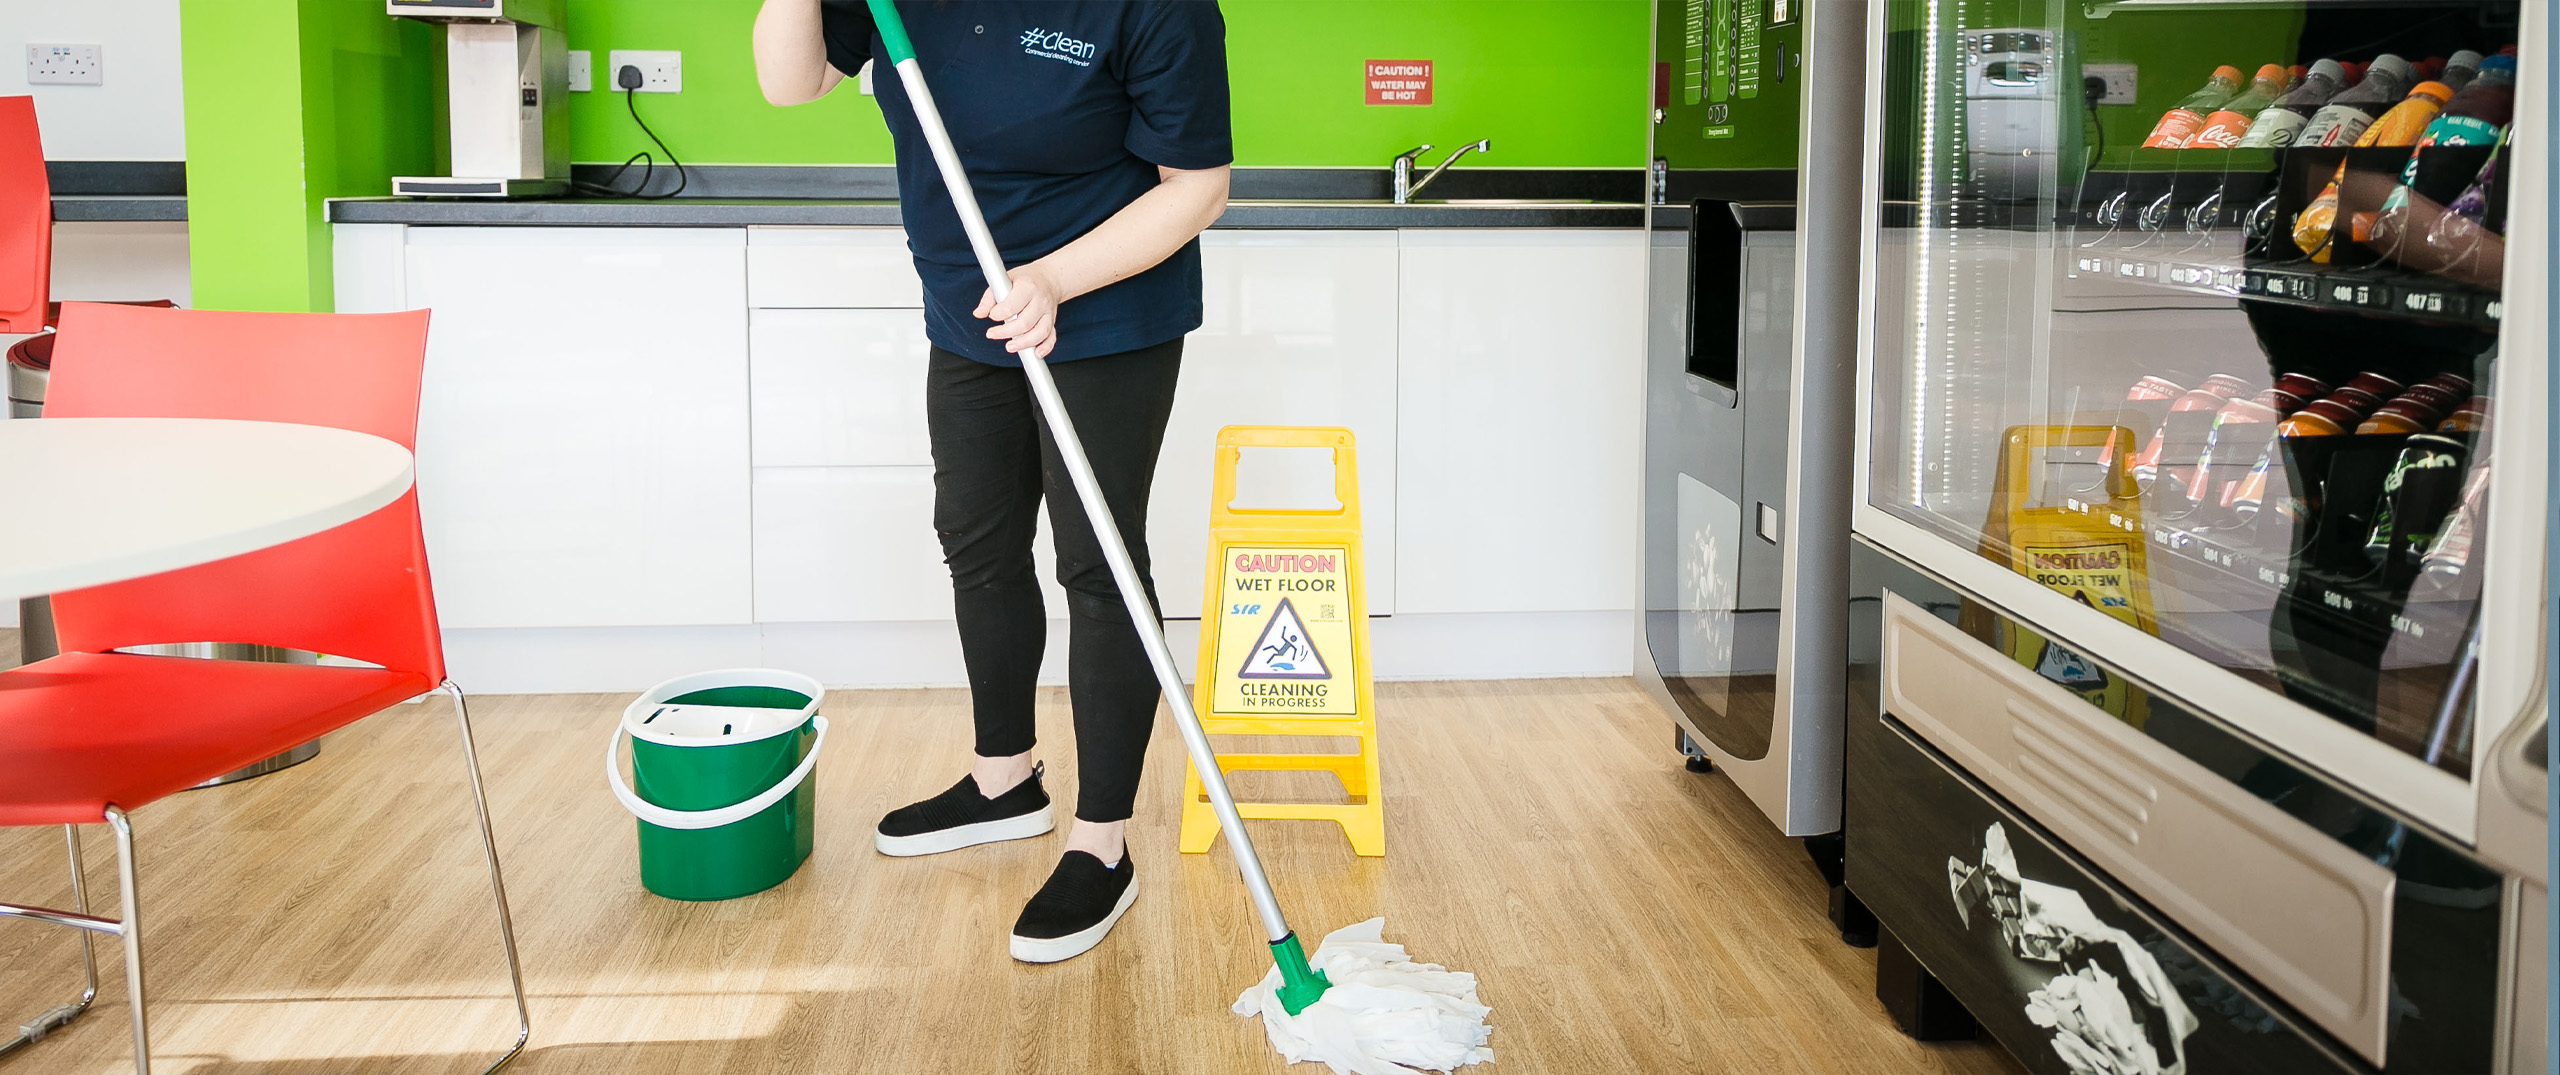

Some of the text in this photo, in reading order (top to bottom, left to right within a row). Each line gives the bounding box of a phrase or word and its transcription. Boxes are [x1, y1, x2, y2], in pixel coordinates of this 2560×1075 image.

[1020, 27, 1096, 59] #Clean
[1375, 65, 1423, 76] CAUTION
[1371, 80, 1426, 89] WATER MAY
[1381, 91, 1416, 100] BE HOT
[2120, 263, 2134, 276] 402
[2267, 279, 2284, 293] 405
[2406, 293, 2427, 310] 407
[1235, 554, 1335, 572] CAUTION
[1236, 578, 1335, 592] WET FLOOR
[1241, 683, 1328, 697] CLEANING
[1243, 697, 1326, 707] IN PROGRESS
